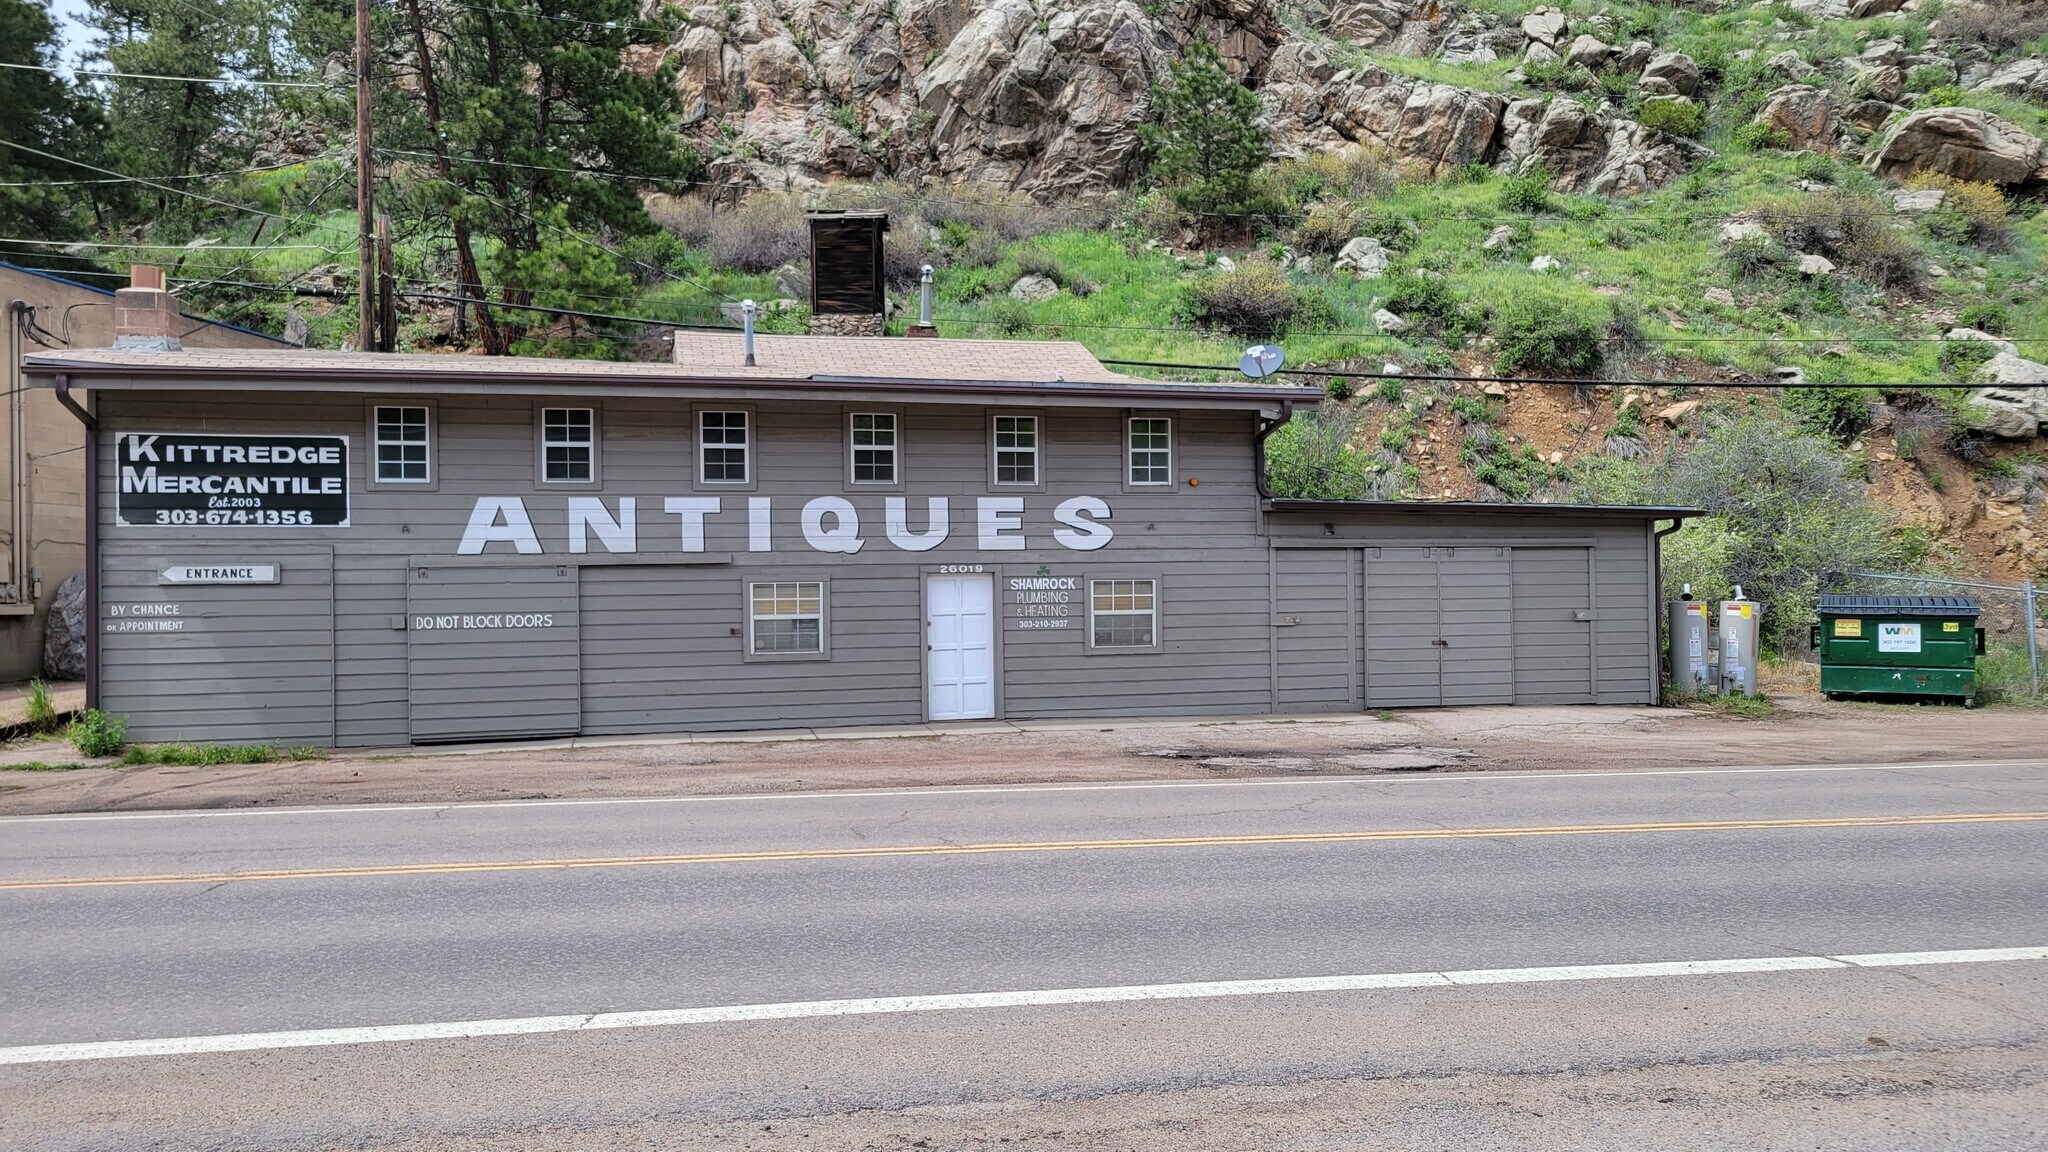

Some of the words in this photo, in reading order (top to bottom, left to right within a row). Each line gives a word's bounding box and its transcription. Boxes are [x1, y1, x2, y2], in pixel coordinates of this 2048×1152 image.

[128, 435, 340, 464] KITTREDGE
[122, 466, 343, 494] MERCANTILE
[156, 509, 313, 525] 303-674-1356
[456, 496, 1114, 556] ANTIQUES
[186, 568, 253, 579] ENTRANCE
[940, 565, 983, 573] 26019
[1010, 577, 1076, 590] SHAMROCK
[1016, 591, 1069, 604] PLUMBING
[111, 605, 126, 616] BY
[132, 604, 180, 615] CHANCE
[1016, 608, 1024, 617] &
[1025, 604, 1068, 617] HEATING
[119, 621, 184, 631] APPOINTMENT
[416, 616, 433, 629] DO
[436, 615, 459, 629] NOT
[463, 615, 502, 629] BLOCK
[506, 614, 553, 628] DOORS
[1018, 620, 1068, 629] 303-210-2937
[1885, 627, 1914, 635] WM
